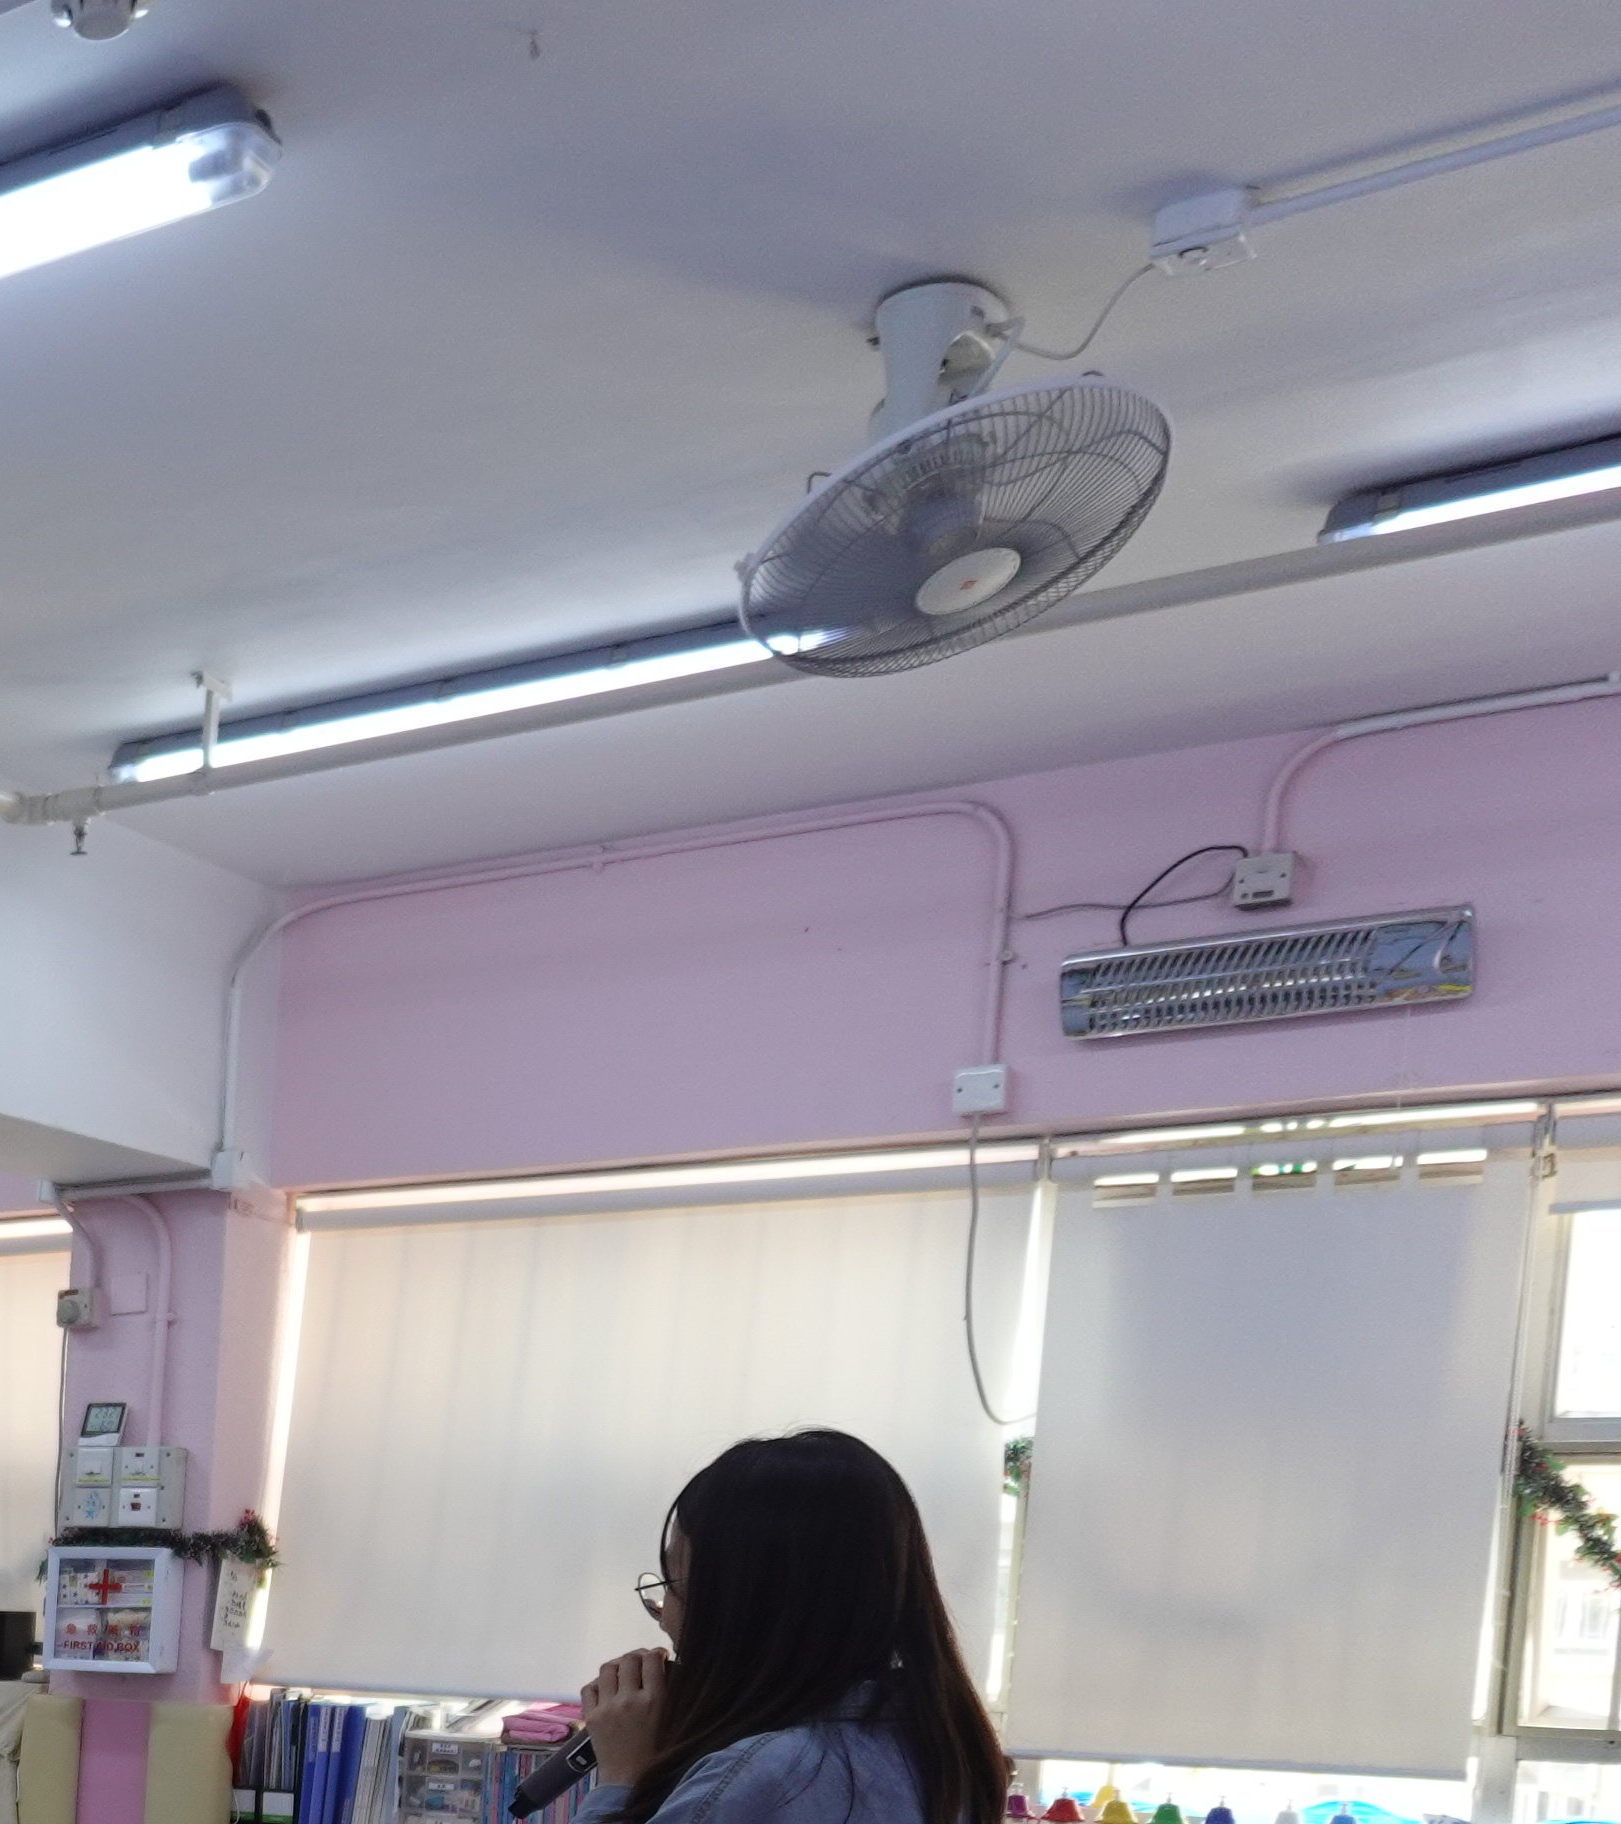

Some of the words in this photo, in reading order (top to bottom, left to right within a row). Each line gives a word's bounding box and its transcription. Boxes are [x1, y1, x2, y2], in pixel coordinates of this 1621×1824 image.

[63, 1640, 93, 1651] FIRST
[96, 1641, 114, 1652] AID
[117, 1642, 140, 1653] BOX
